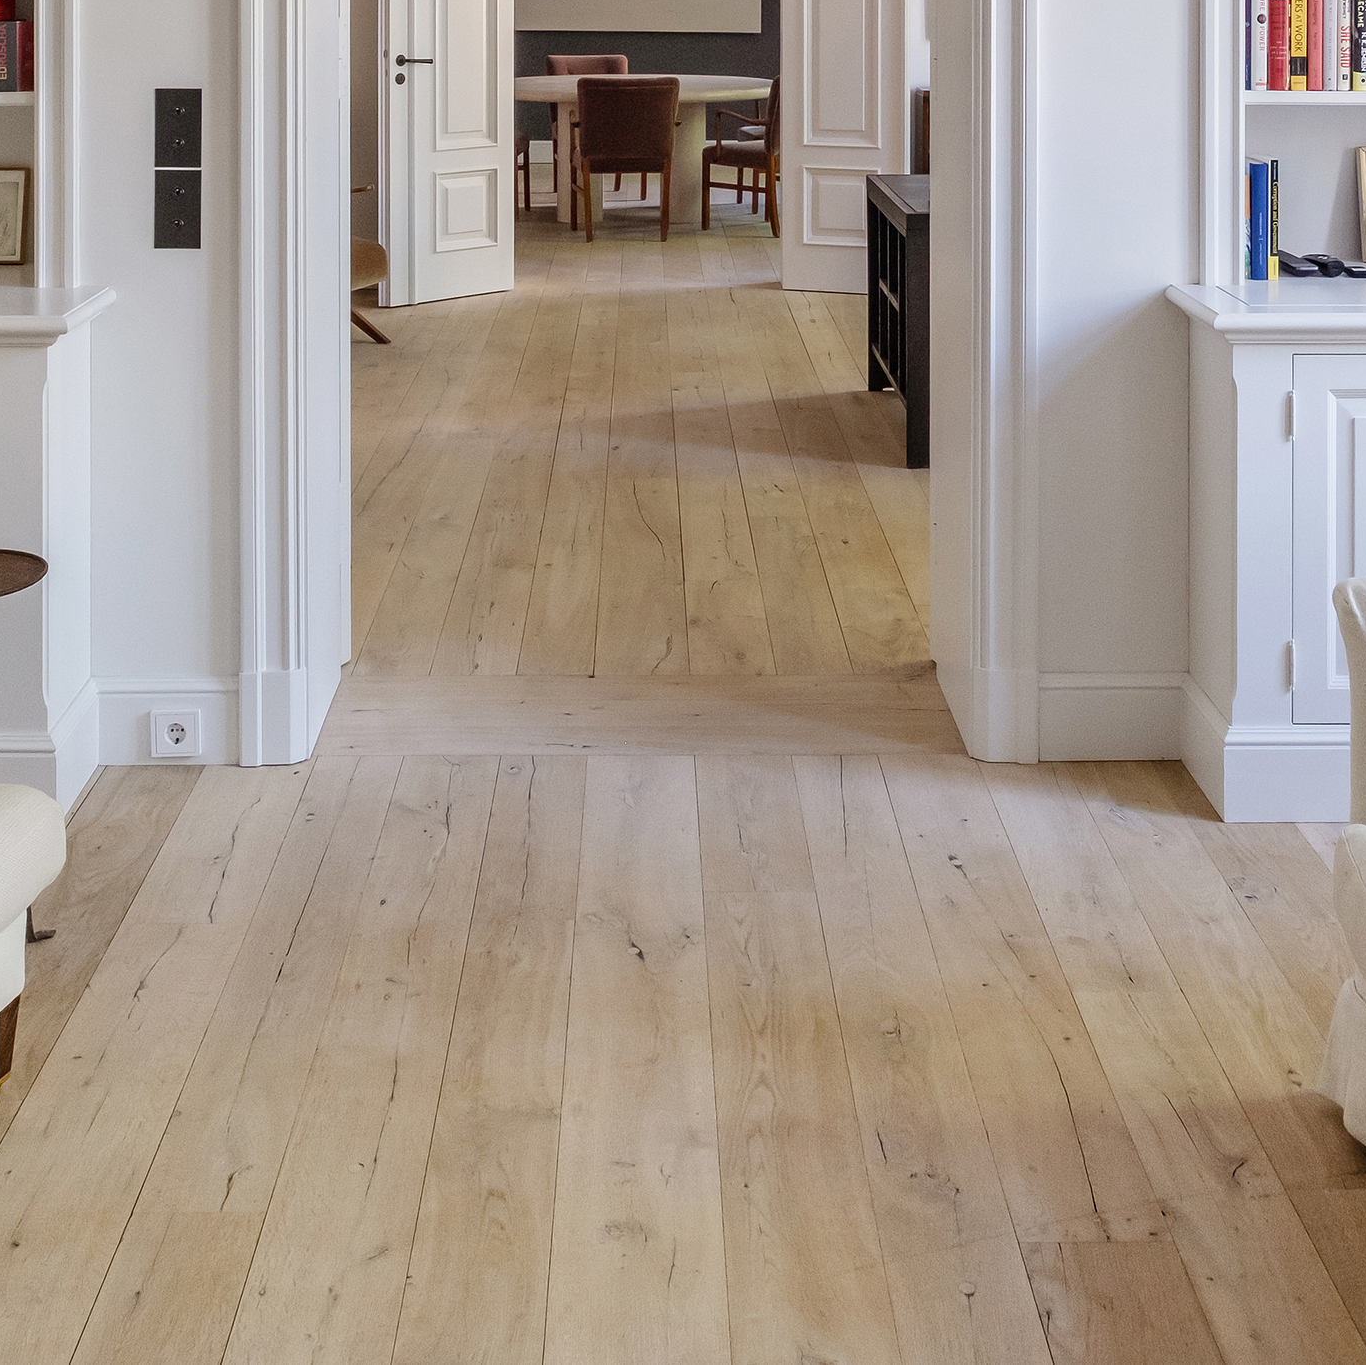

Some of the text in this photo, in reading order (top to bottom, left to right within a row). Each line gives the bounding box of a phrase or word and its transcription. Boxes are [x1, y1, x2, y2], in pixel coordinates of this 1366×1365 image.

[1295, 14, 1301, 23] AT
[1295, 24, 1303, 52] WORK
[1340, 26, 1350, 68] SHE SAID
